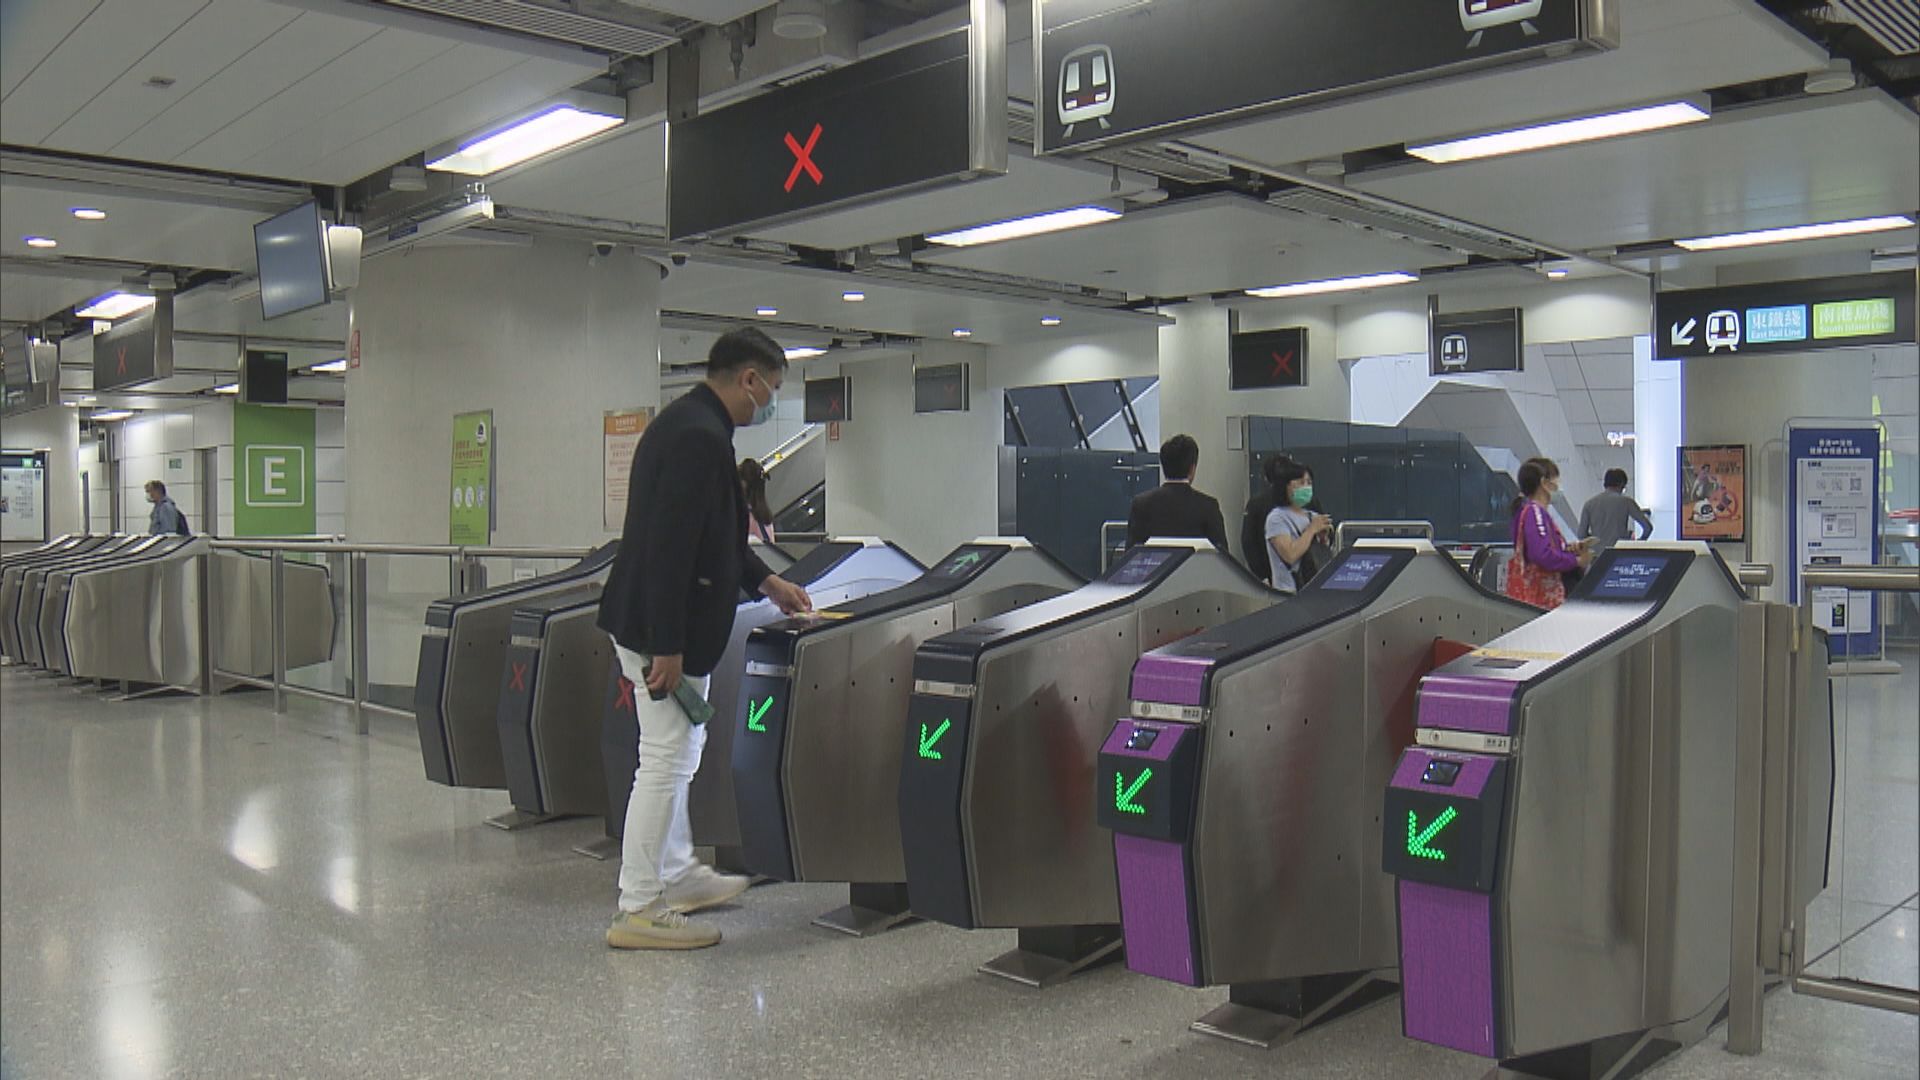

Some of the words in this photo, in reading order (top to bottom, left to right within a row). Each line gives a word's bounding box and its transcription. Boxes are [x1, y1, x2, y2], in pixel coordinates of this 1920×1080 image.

[1844, 323, 1869, 332] Island
[1871, 321, 1889, 331] Line
[1751, 330, 1767, 339] East
[1768, 329, 1784, 338] Rail
[1784, 328, 1801, 337] Line
[265, 456, 286, 496] E
